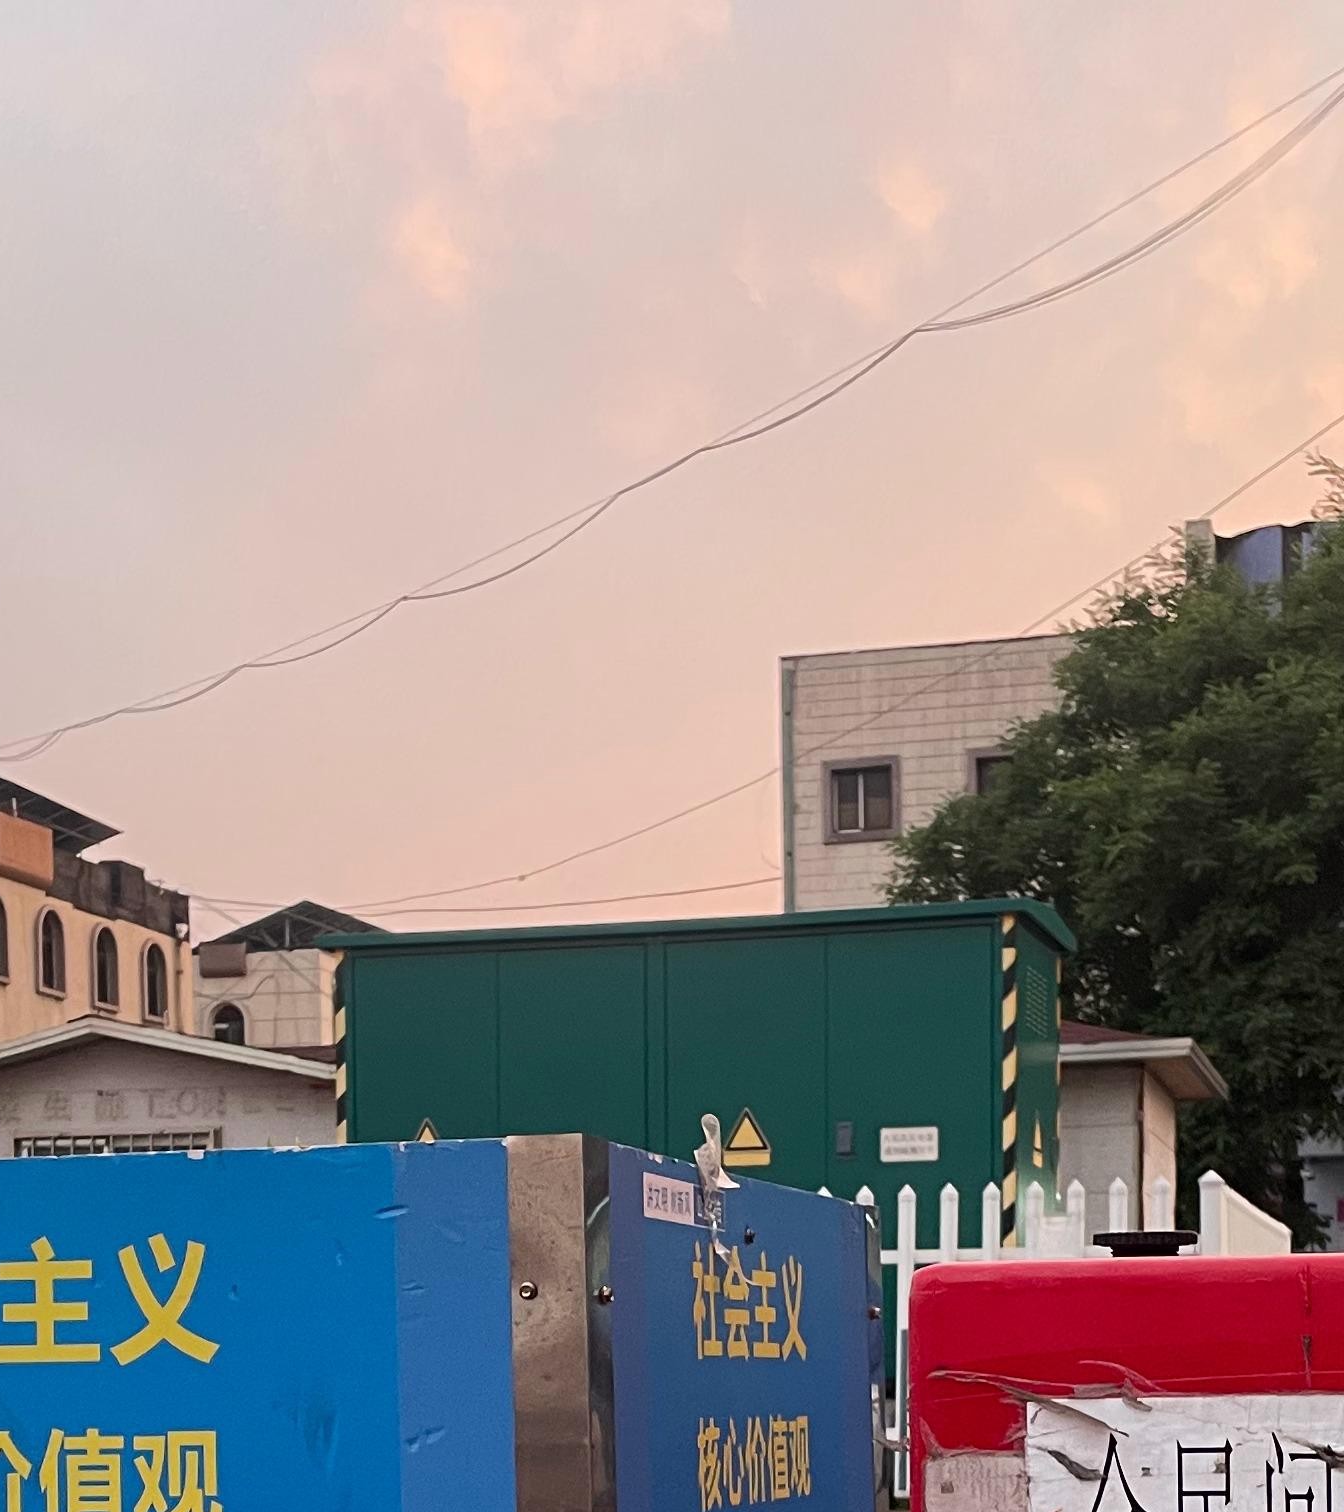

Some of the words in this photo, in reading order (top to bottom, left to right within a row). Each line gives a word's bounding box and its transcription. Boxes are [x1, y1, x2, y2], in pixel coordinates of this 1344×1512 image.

[692, 1240, 808, 1362] 社会主义
[697, 1414, 811, 1512] 核心价值观
